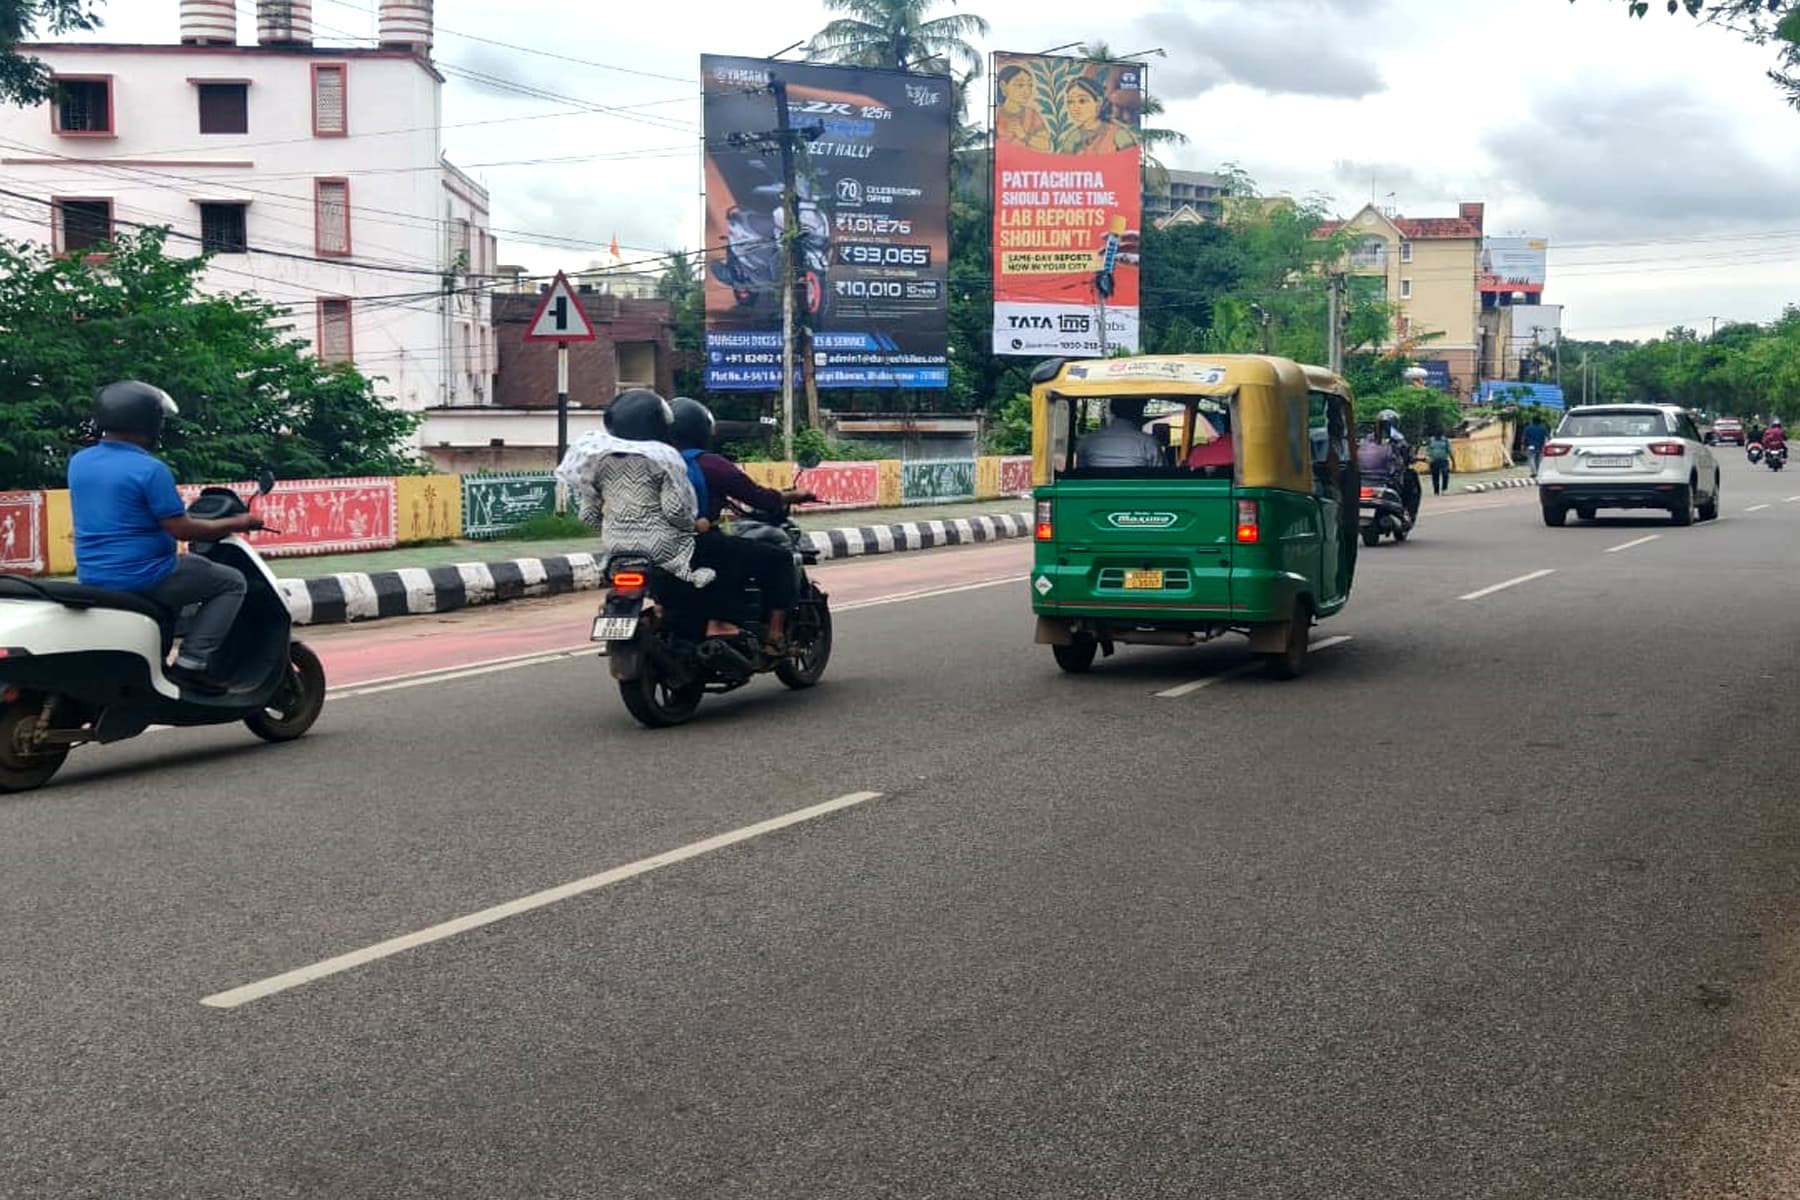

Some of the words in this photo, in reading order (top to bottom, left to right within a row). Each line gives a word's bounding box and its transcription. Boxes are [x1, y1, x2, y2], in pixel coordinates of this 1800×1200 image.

[1002, 171, 1104, 189] PATTACHITRA
[840, 182, 857, 198] 70
[1002, 191, 1049, 206] SHOULD
[1053, 191, 1083, 206] TAKE
[1086, 191, 1119, 207] TIME,
[1001, 208, 1031, 227] LAB
[1036, 209, 1105, 227] REPORTS
[1000, 229, 1091, 248] SHOULDN'T!
[1008, 316, 1053, 328] TATA
